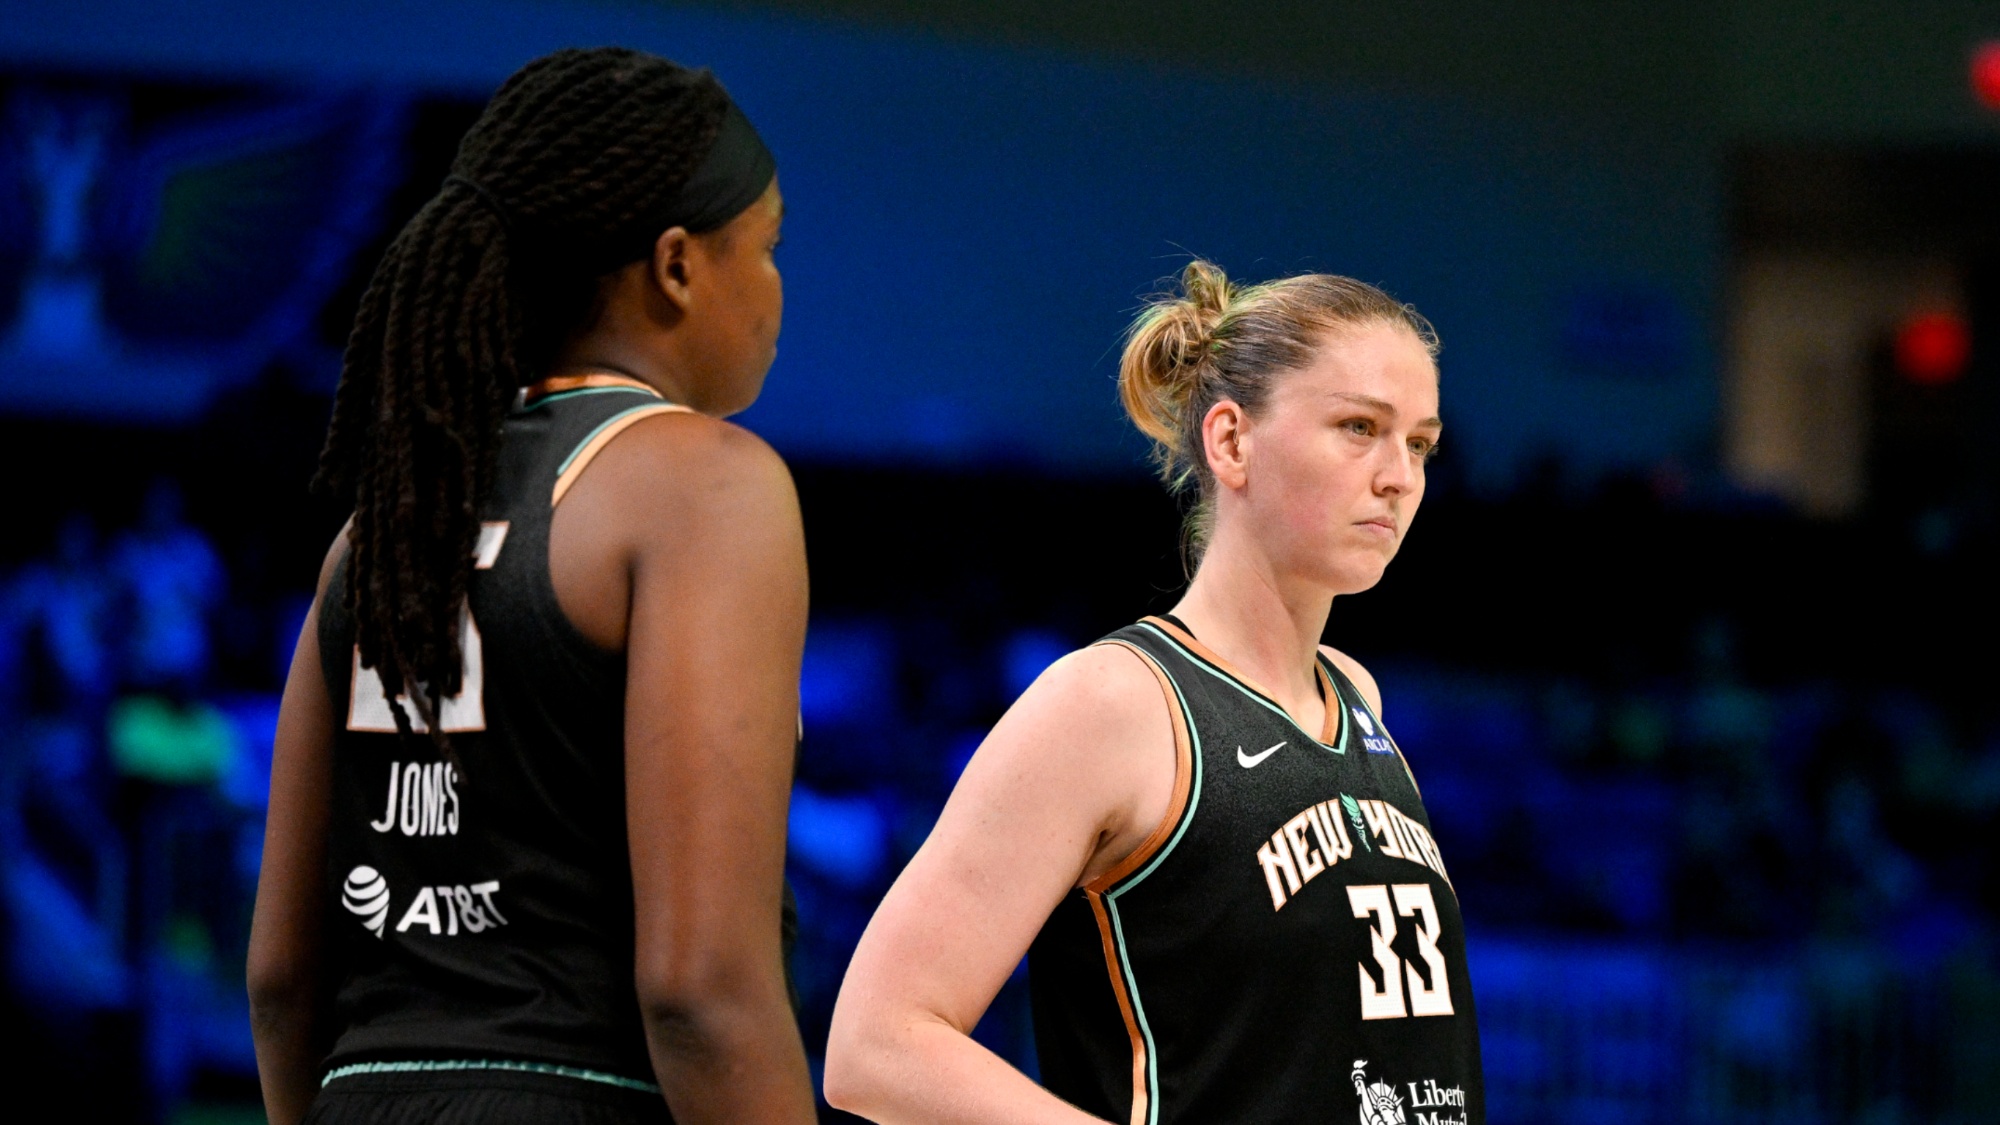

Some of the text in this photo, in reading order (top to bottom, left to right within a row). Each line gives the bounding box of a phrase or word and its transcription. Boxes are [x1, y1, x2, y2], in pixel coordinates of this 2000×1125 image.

[370, 761, 460, 837] JONES
[1256, 798, 1353, 911] NEW
[395, 880, 509, 937] AT&T
[1345, 883, 1455, 1021] 33
[1407, 1079, 1466, 1119] Liberty
